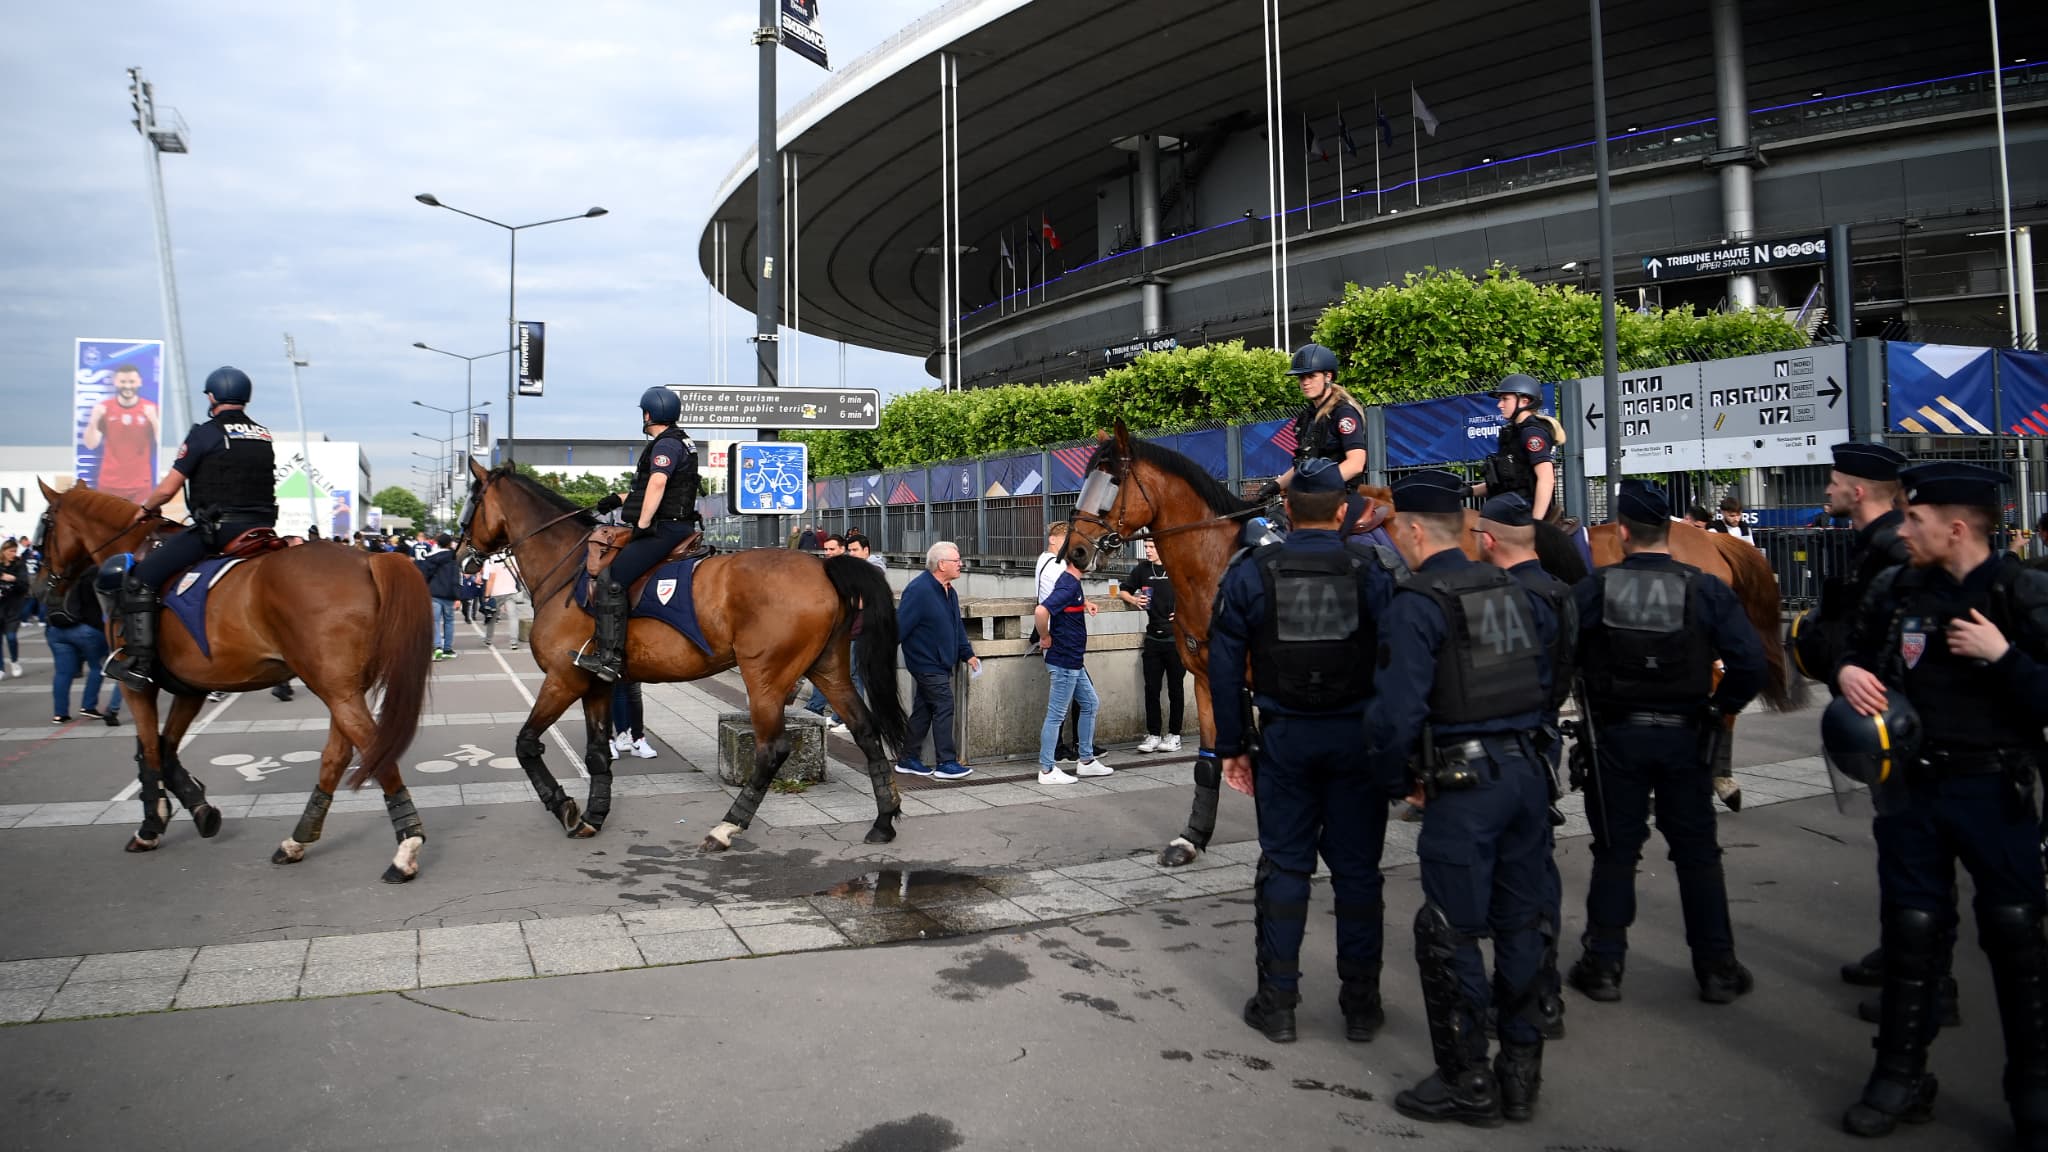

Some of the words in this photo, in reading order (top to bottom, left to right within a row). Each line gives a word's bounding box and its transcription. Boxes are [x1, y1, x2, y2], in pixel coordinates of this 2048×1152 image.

[1666, 252, 1711, 267] TRIBUNE
[1713, 247, 1750, 261] HAUTE
[1754, 244, 1770, 264] N
[1696, 261, 1721, 271] UPPER
[1722, 257, 1750, 268] STAND
[1776, 363, 1788, 377] N
[1625, 382, 1632, 395] L
[1638, 380, 1646, 393] K
[1653, 378, 1659, 392] J
[683, 393, 713, 402] office
[718, 393, 730, 402] de
[736, 394, 780, 402] tourisme
[840, 396, 846, 404] 6
[848, 396, 862, 404] min
[1712, 394, 1722, 407] R
[1728, 391, 1738, 405] S
[1744, 389, 1754, 403] T
[1761, 387, 1771, 401] U
[1777, 386, 1789, 400] X
[680, 403, 739, 412] blissement
[743, 404, 775, 414] public
[1624, 403, 1634, 416] H
[1638, 401, 1648, 415] G
[1653, 399, 1661, 413] E
[1666, 398, 1677, 412] D
[1681, 396, 1691, 410] C
[679, 414, 705, 423] laine
[709, 414, 757, 423] Commune
[840, 411, 846, 419] 6
[1761, 411, 1771, 425] Y
[1778, 410, 1789, 424] Z
[224, 423, 270, 435] POLICE
[1626, 424, 1634, 436] B
[1640, 423, 1648, 435] A
[1614, 577, 1671, 625] 4A
[1480, 594, 1532, 655] 4A
